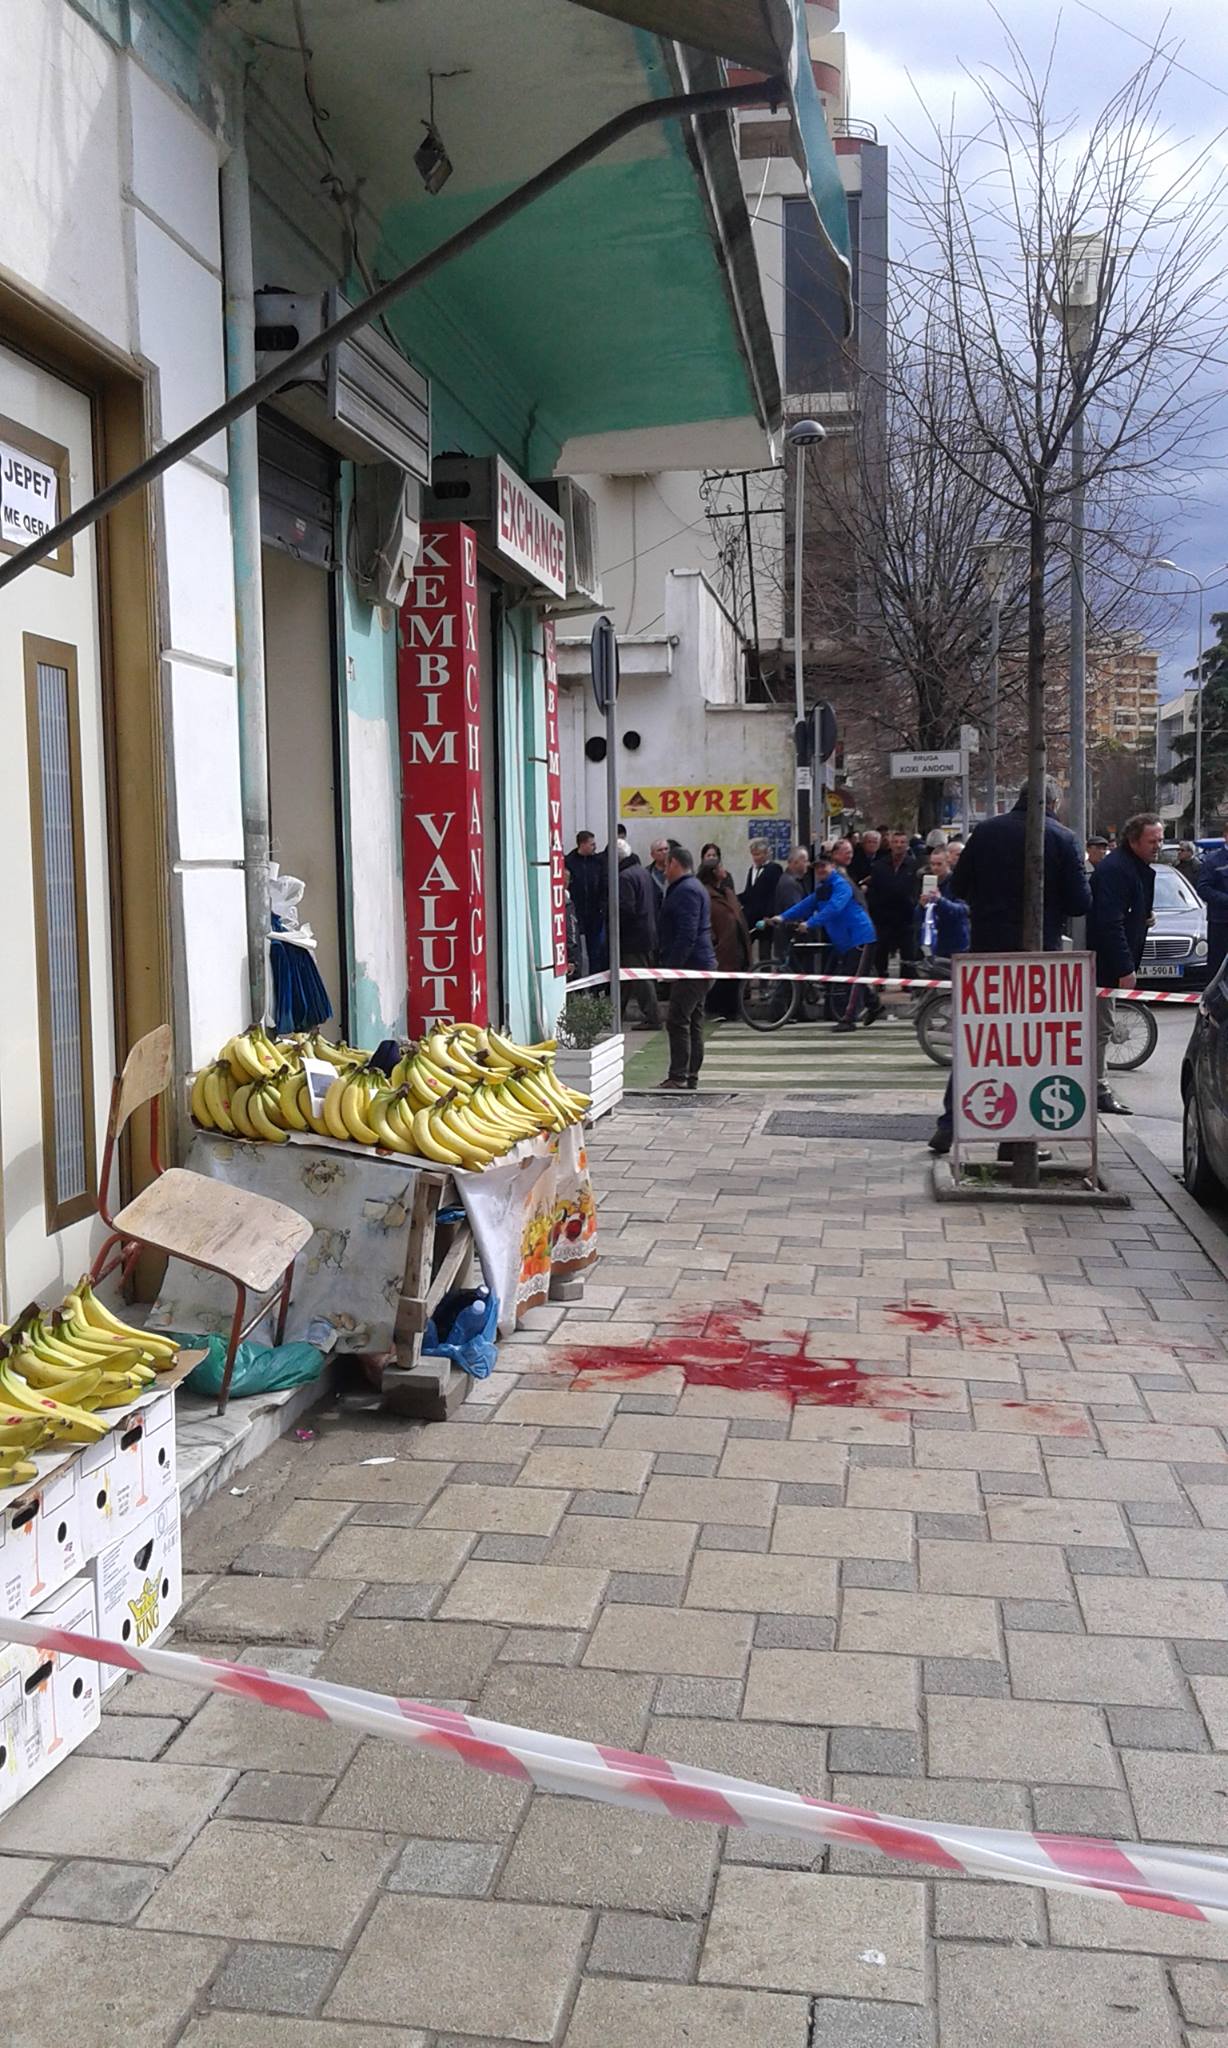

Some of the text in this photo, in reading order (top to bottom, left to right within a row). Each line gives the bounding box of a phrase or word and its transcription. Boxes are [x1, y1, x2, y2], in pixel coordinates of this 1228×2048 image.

[4, 458, 51, 499] JEPET
[4, 505, 21, 528] ME
[500, 472, 565, 584] EXCHANGE
[407, 533, 458, 764] KEMBIM
[658, 788, 775, 813] BYREK
[550, 800, 566, 966] VALUTE
[961, 962, 1083, 1015] KEMBIM
[963, 1021, 1083, 1068] VALUTE
[135, 1603, 160, 1648] KING
